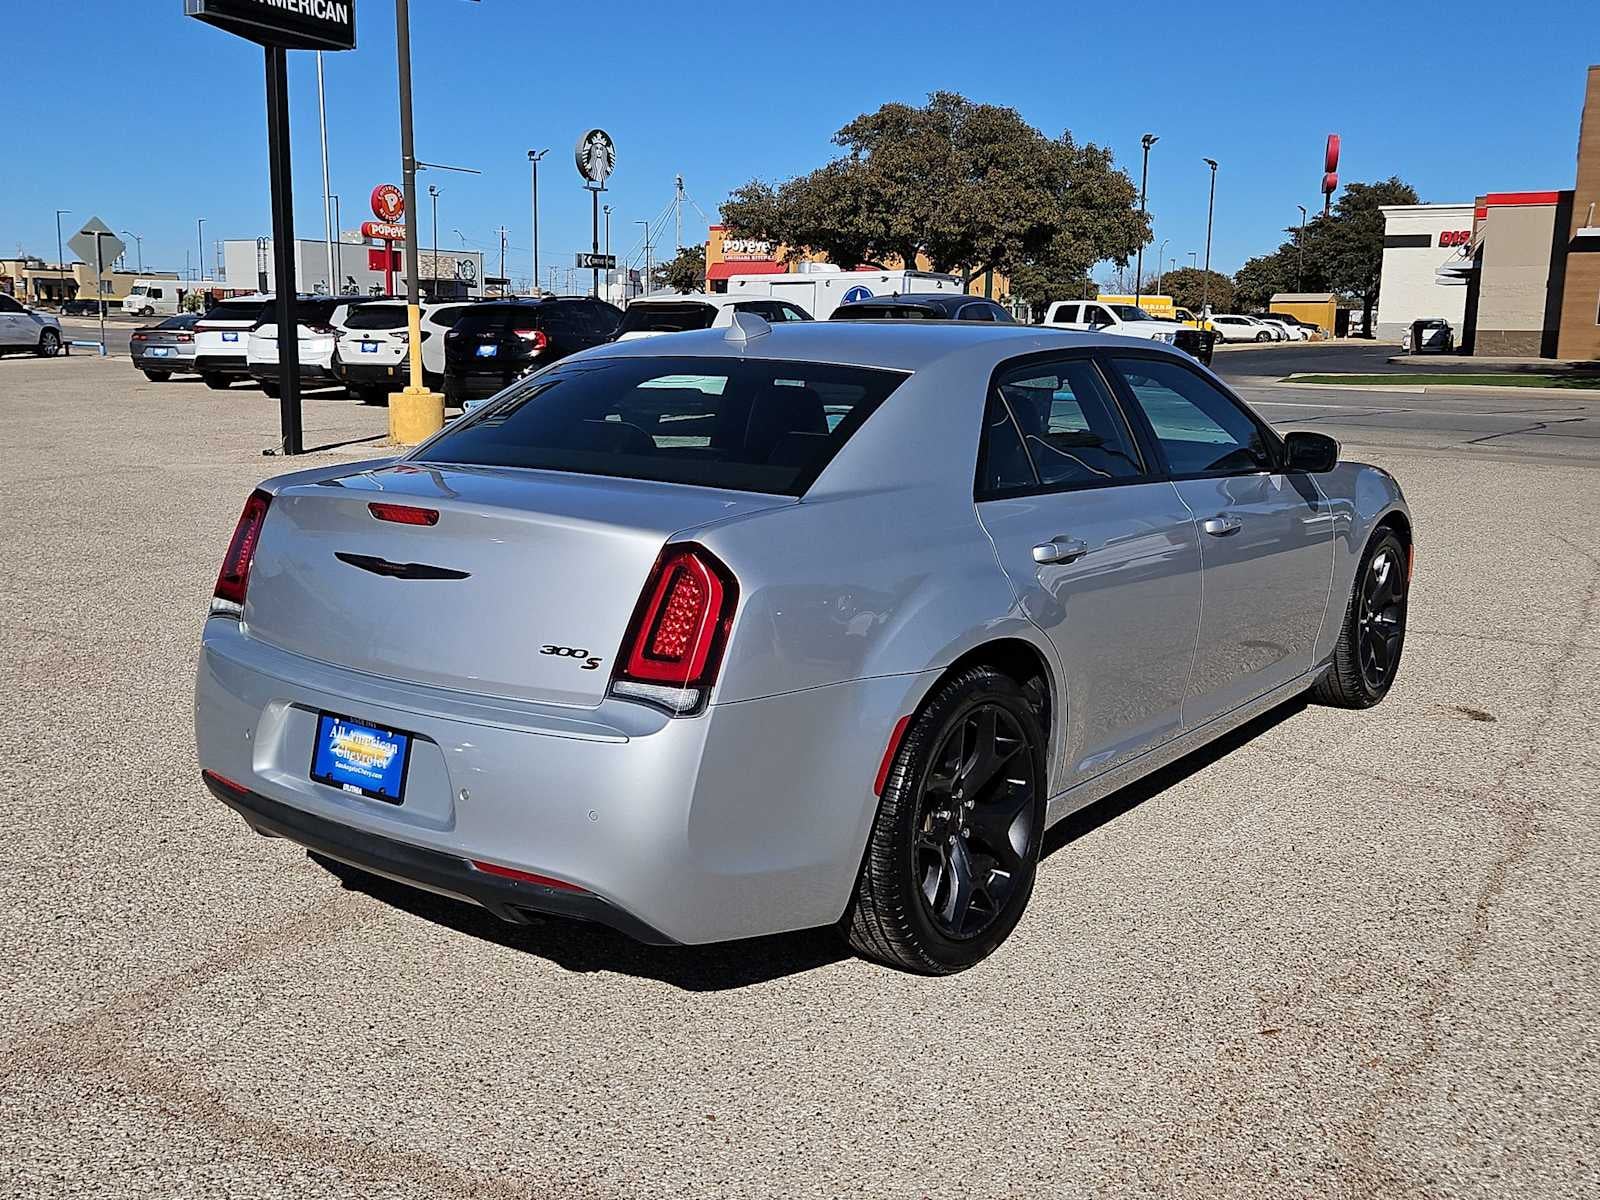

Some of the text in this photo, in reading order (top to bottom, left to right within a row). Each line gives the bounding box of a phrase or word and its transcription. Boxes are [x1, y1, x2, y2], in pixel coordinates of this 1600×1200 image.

[259, 0, 347, 24] MERICAN
[540, 645, 603, 670] 300 S
[329, 725, 398, 754] All American
[335, 744, 391, 769] Chevrolet
